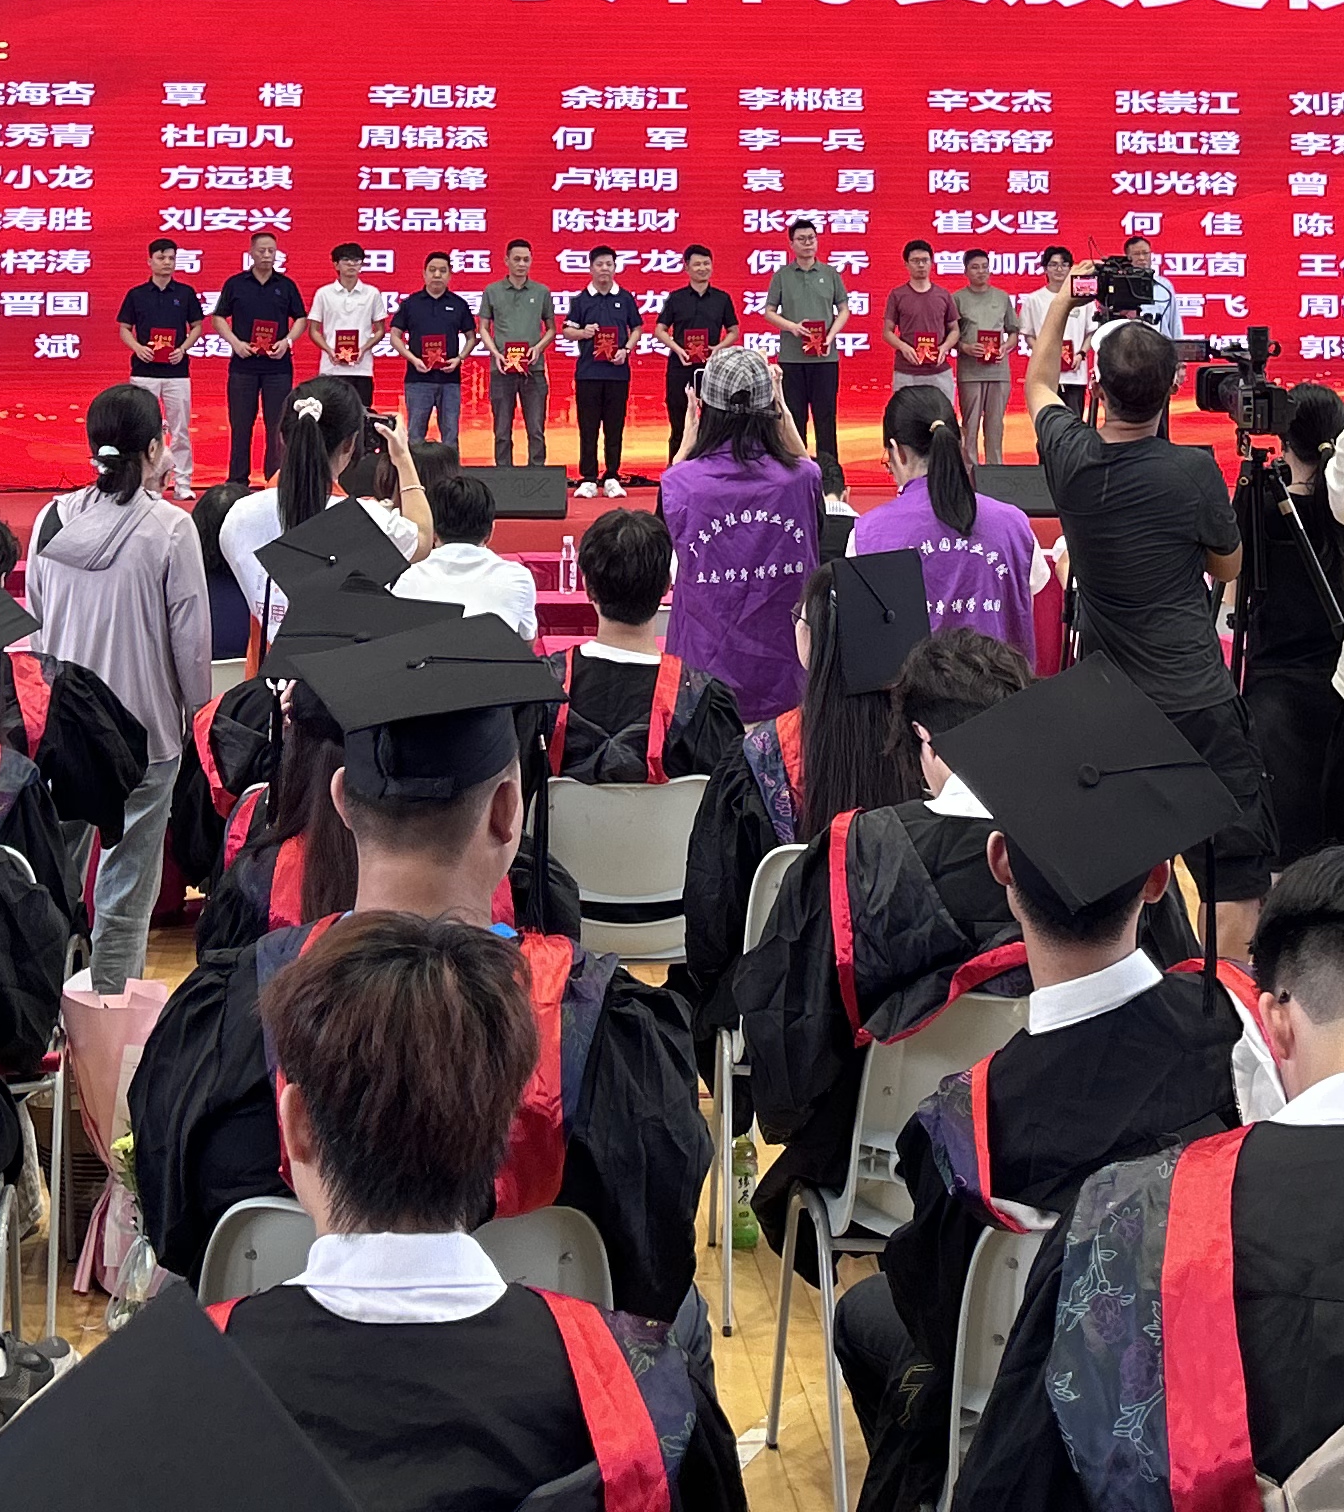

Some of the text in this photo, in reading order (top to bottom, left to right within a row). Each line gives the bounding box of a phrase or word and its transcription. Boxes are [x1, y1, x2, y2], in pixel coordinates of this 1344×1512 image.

[367, 83, 497, 109] 辛旭波
[561, 85, 688, 110] 余满江
[927, 88, 1052, 113] 辛文杰
[1115, 89, 1240, 114] 张崇江
[161, 123, 294, 148] 杜向凡
[358, 125, 488, 150] 周锦添
[738, 127, 865, 152] 李一兵
[928, 128, 1054, 153] 陈舒舒
[1115, 130, 1241, 155] 陈虹澄
[160, 165, 293, 190] 方远琪
[357, 166, 488, 191] 江育锋
[551, 167, 678, 192] 卢辉明
[159, 206, 292, 232] 刘安兴
[357, 207, 487, 232] 张品福
[552, 207, 680, 233] 陈进财
[932, 209, 1059, 234] 崔火坚
[908, 536, 1009, 580] 桂园职业学院
